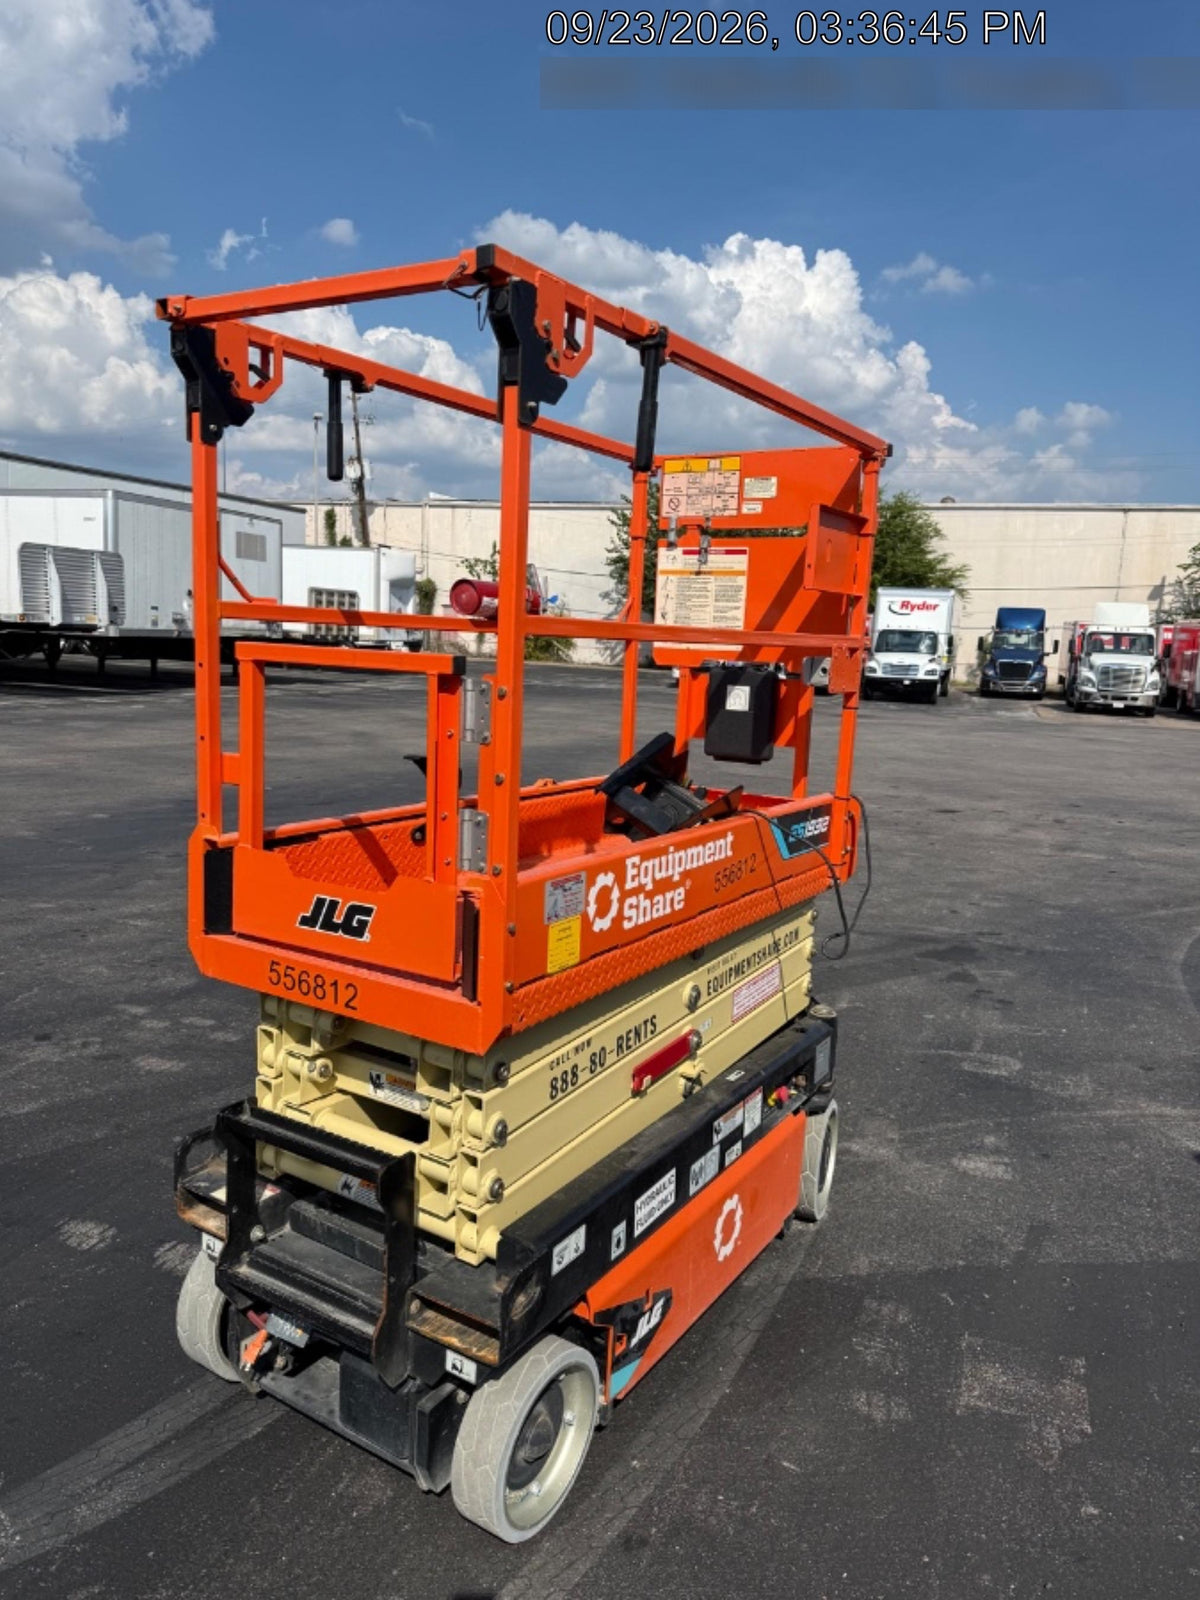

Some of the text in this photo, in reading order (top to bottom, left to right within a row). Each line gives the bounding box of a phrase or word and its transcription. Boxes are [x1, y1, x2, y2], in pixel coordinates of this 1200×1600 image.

[900, 600, 940, 613] Ryder
[625, 832, 734, 891] Equipment
[714, 852, 757, 893] 556812
[297, 896, 376, 941] JLG
[623, 886, 685, 930] Share
[268, 960, 358, 1011] 556812
[549, 1037, 593, 1071] CALL NOW
[549, 1014, 657, 1101] 888-80-RENTS
[630, 1297, 666, 1348] JLG
